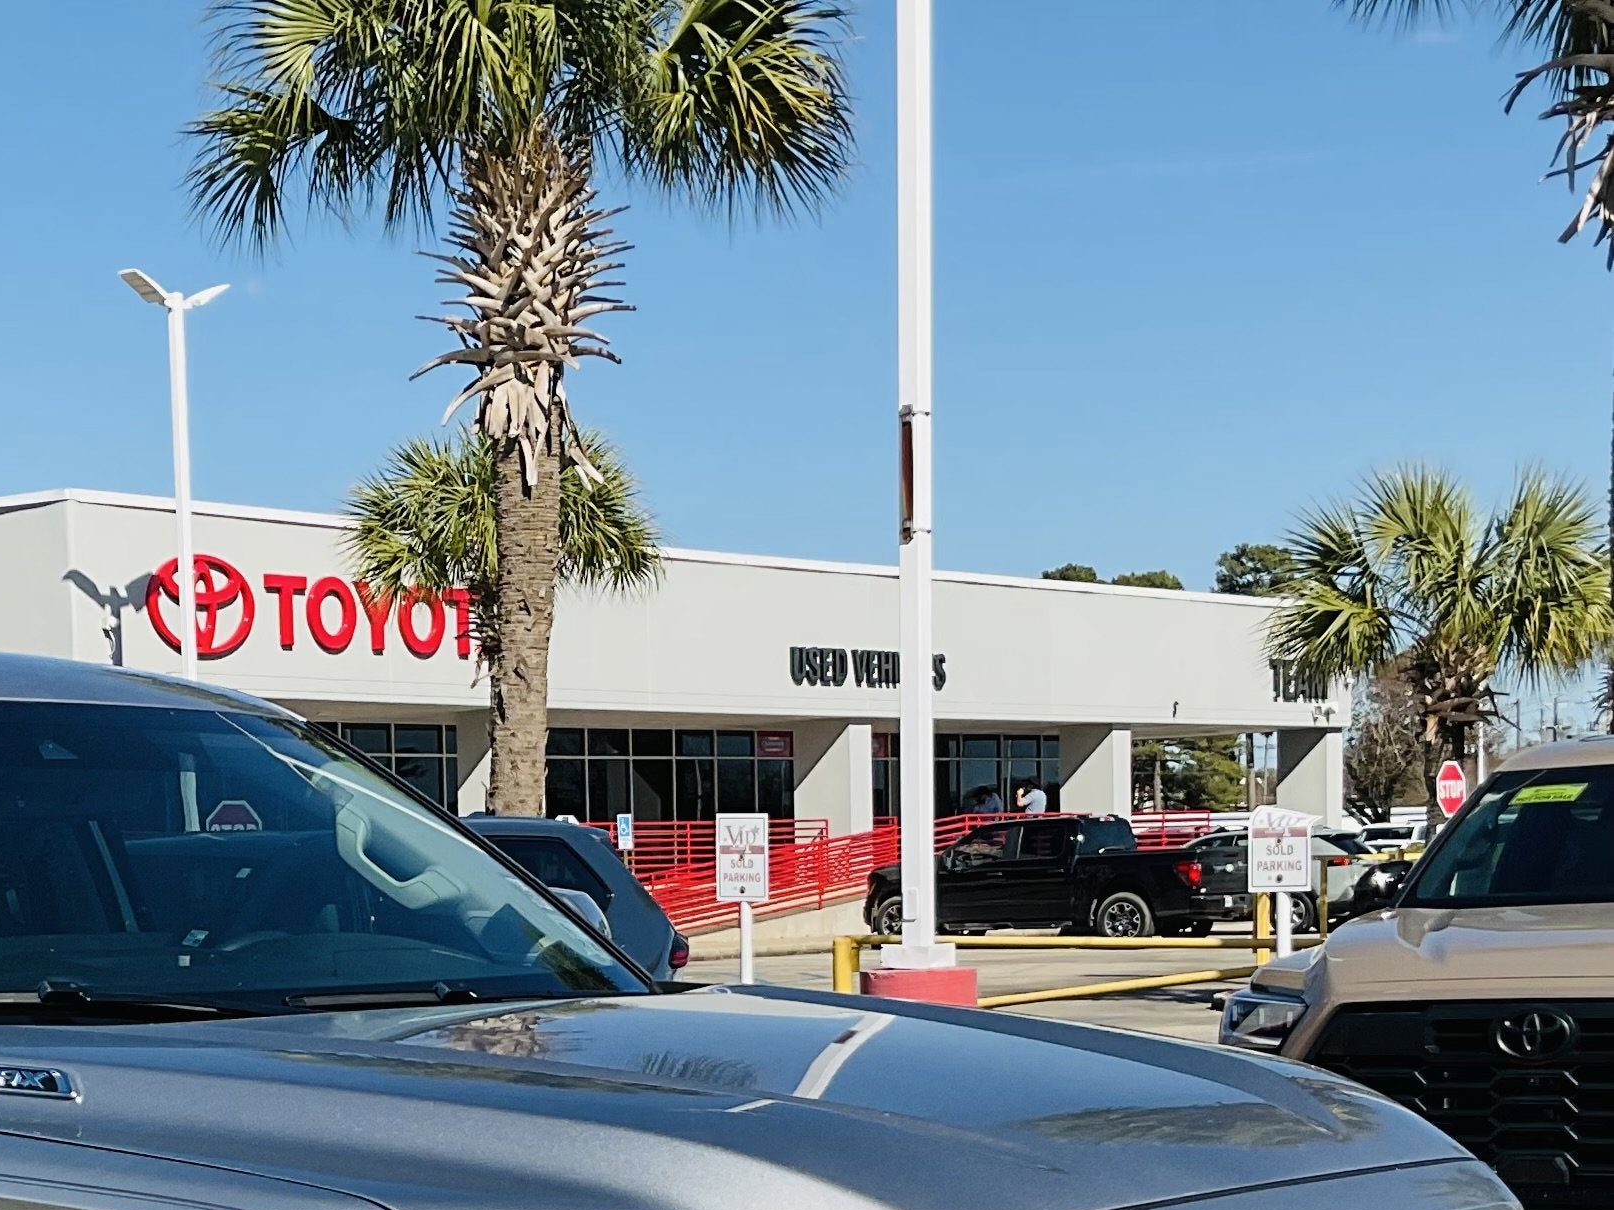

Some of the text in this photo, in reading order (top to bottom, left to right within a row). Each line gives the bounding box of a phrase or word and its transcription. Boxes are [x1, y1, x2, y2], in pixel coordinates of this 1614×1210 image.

[263, 573, 476, 660] TOYOT
[789, 646, 946, 692] USED VEHIS
[1439, 779, 1463, 799] STOP
[1265, 845, 1294, 856] SOLD
[731, 859, 754, 869] SOLD
[1257, 860, 1303, 872] PARKING
[723, 872, 761, 882] PARKING
